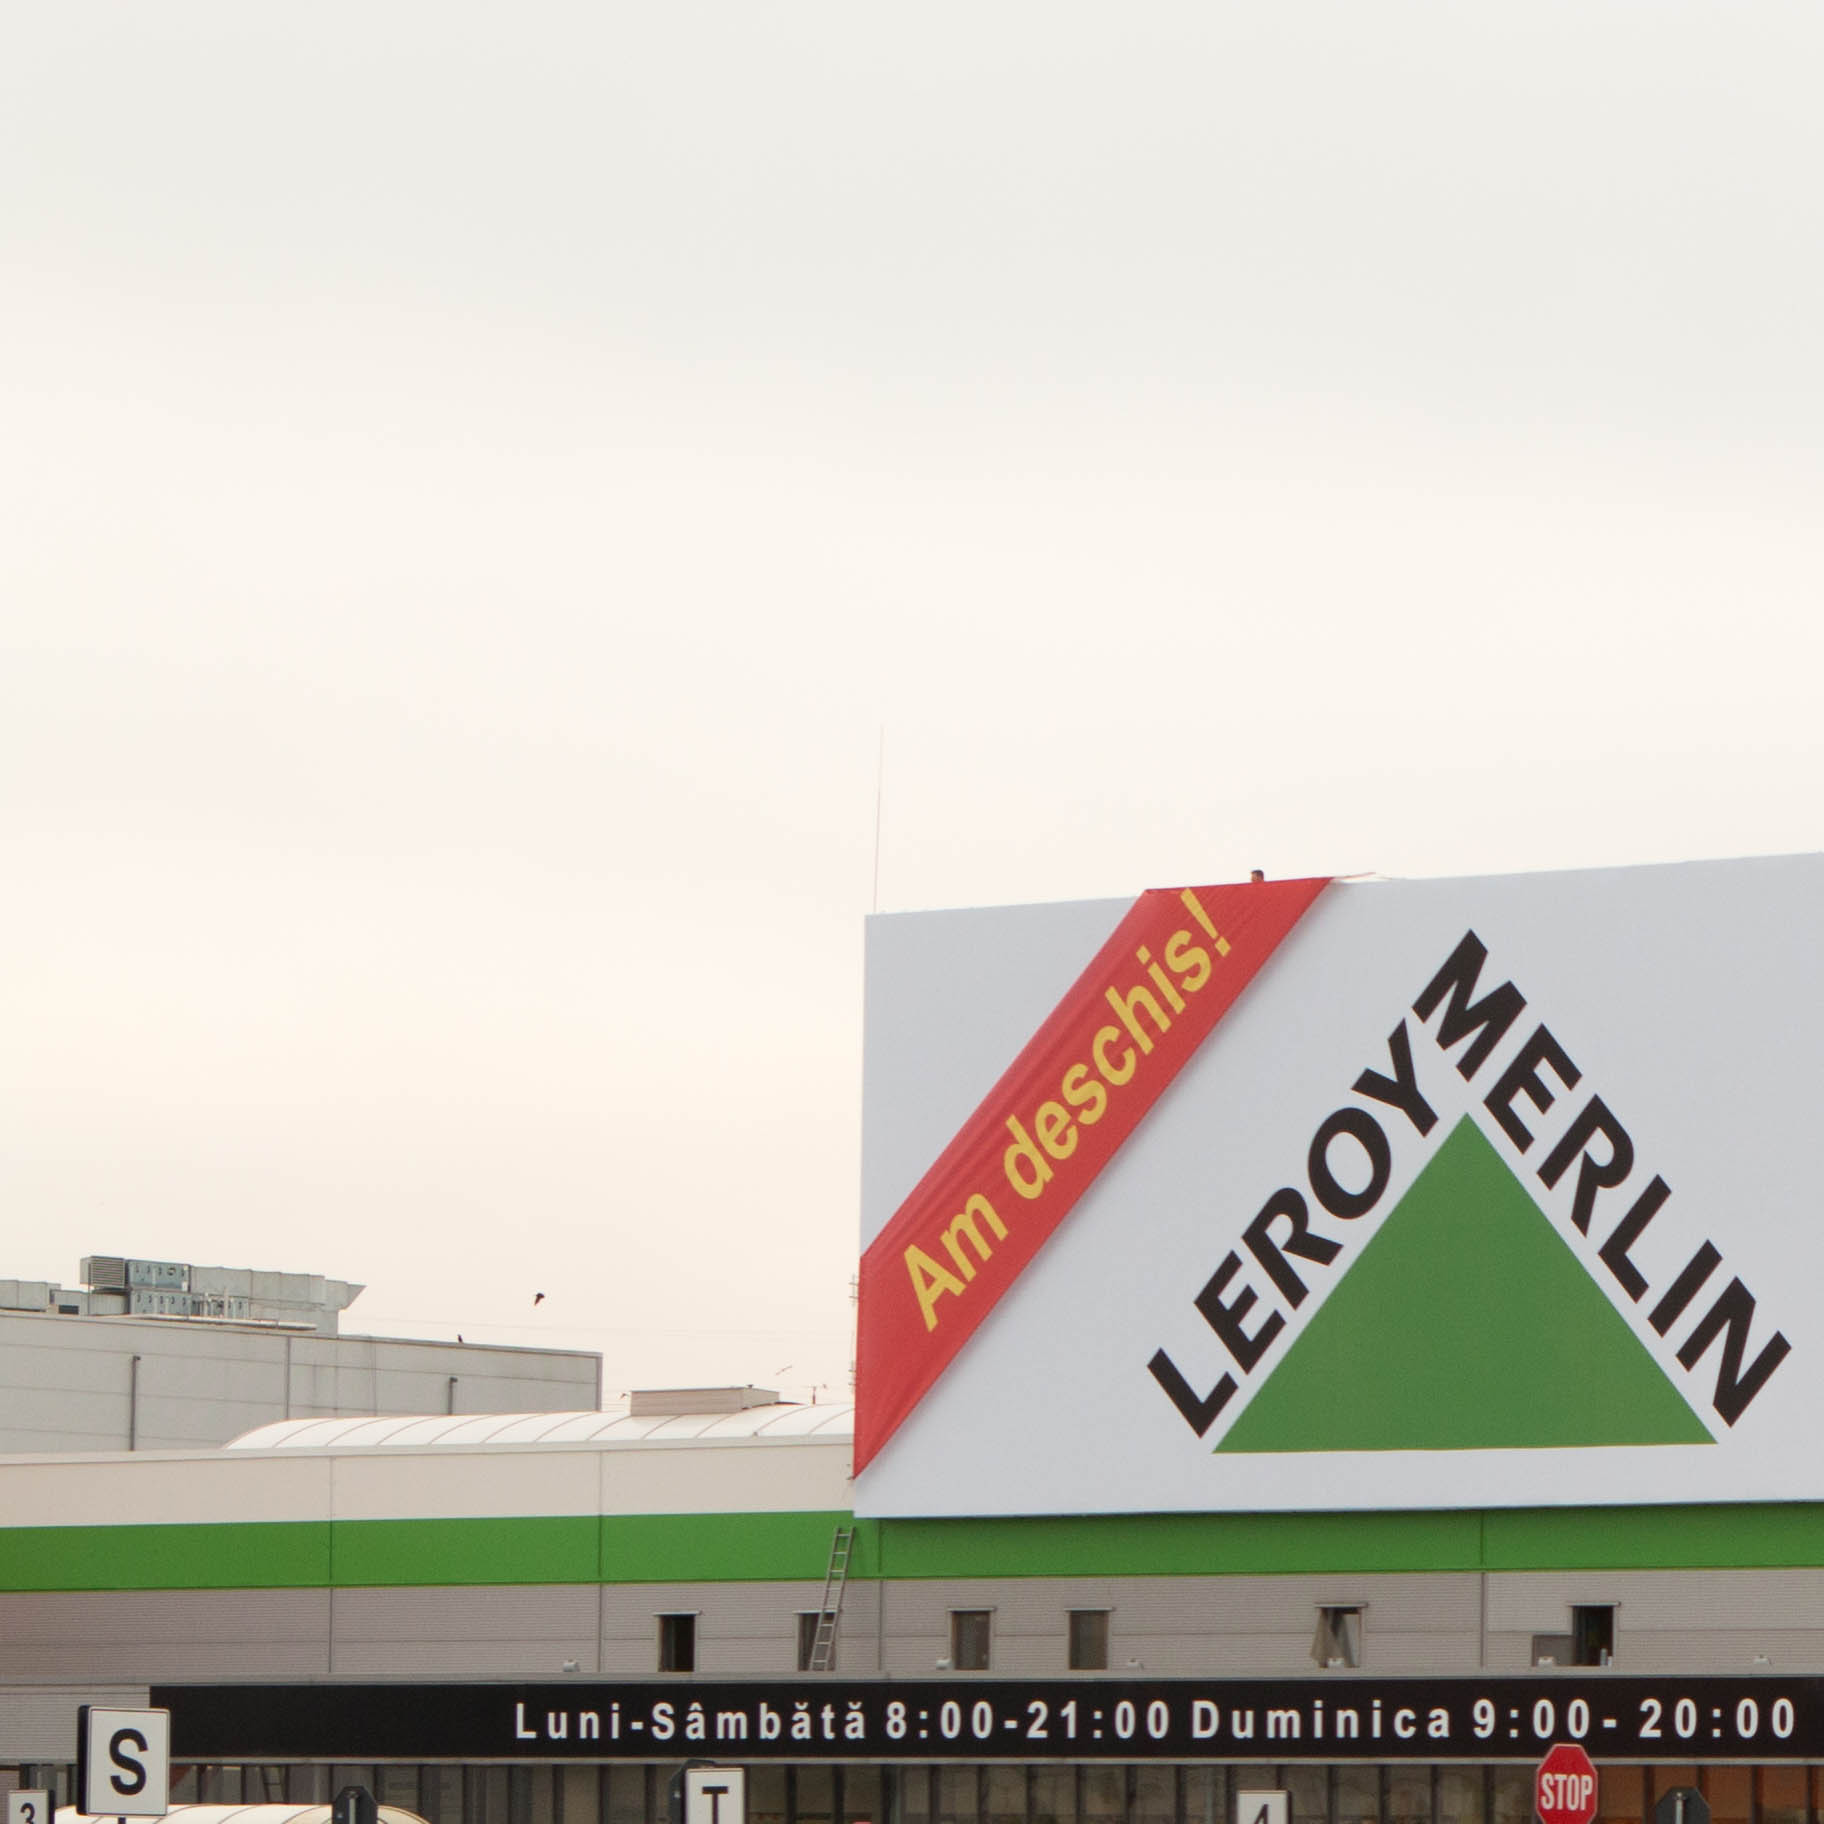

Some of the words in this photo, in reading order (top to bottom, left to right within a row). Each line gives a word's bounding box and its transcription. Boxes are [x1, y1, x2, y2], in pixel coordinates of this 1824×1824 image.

[904, 1193, 1009, 1332] Am
[1004, 887, 1231, 1200] deschis!
[1147, 1017, 1439, 1439] LEROY
[1411, 928, 1792, 1428] MERLIN
[109, 1728, 149, 1796] S
[515, 1700, 867, 1740] Luni-Sâmbătă
[884, 1700, 1171, 1740] 8:00-21:00
[1192, 1698, 1451, 1740] Duminica
[1638, 1698, 1795, 1739] 20:00
[1541, 1773, 1593, 1811] STOP
